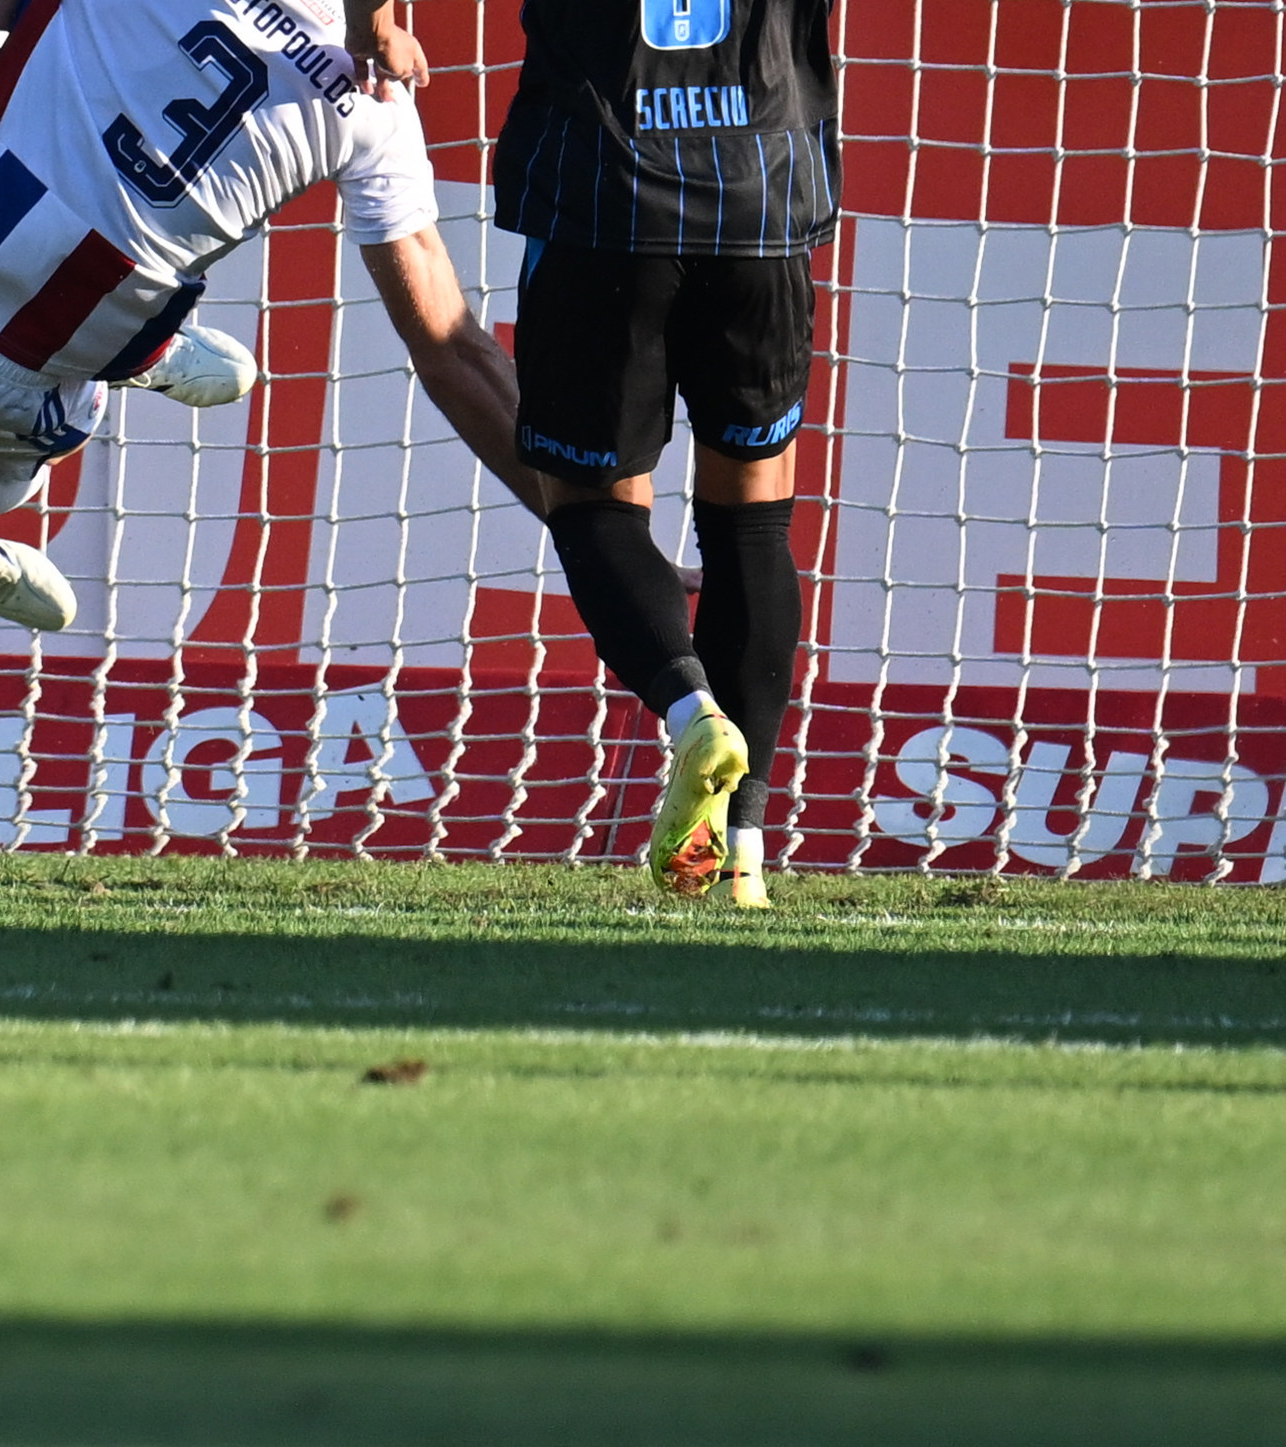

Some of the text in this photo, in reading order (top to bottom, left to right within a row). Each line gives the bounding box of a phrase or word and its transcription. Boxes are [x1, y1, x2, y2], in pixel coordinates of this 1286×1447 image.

[101, 19, 270, 210] 3
[636, 85, 749, 131] SCRECIU
[722, 399, 805, 448] RURIS
[533, 431, 618, 468] PINUM
[873, 726, 1286, 883] SUP
